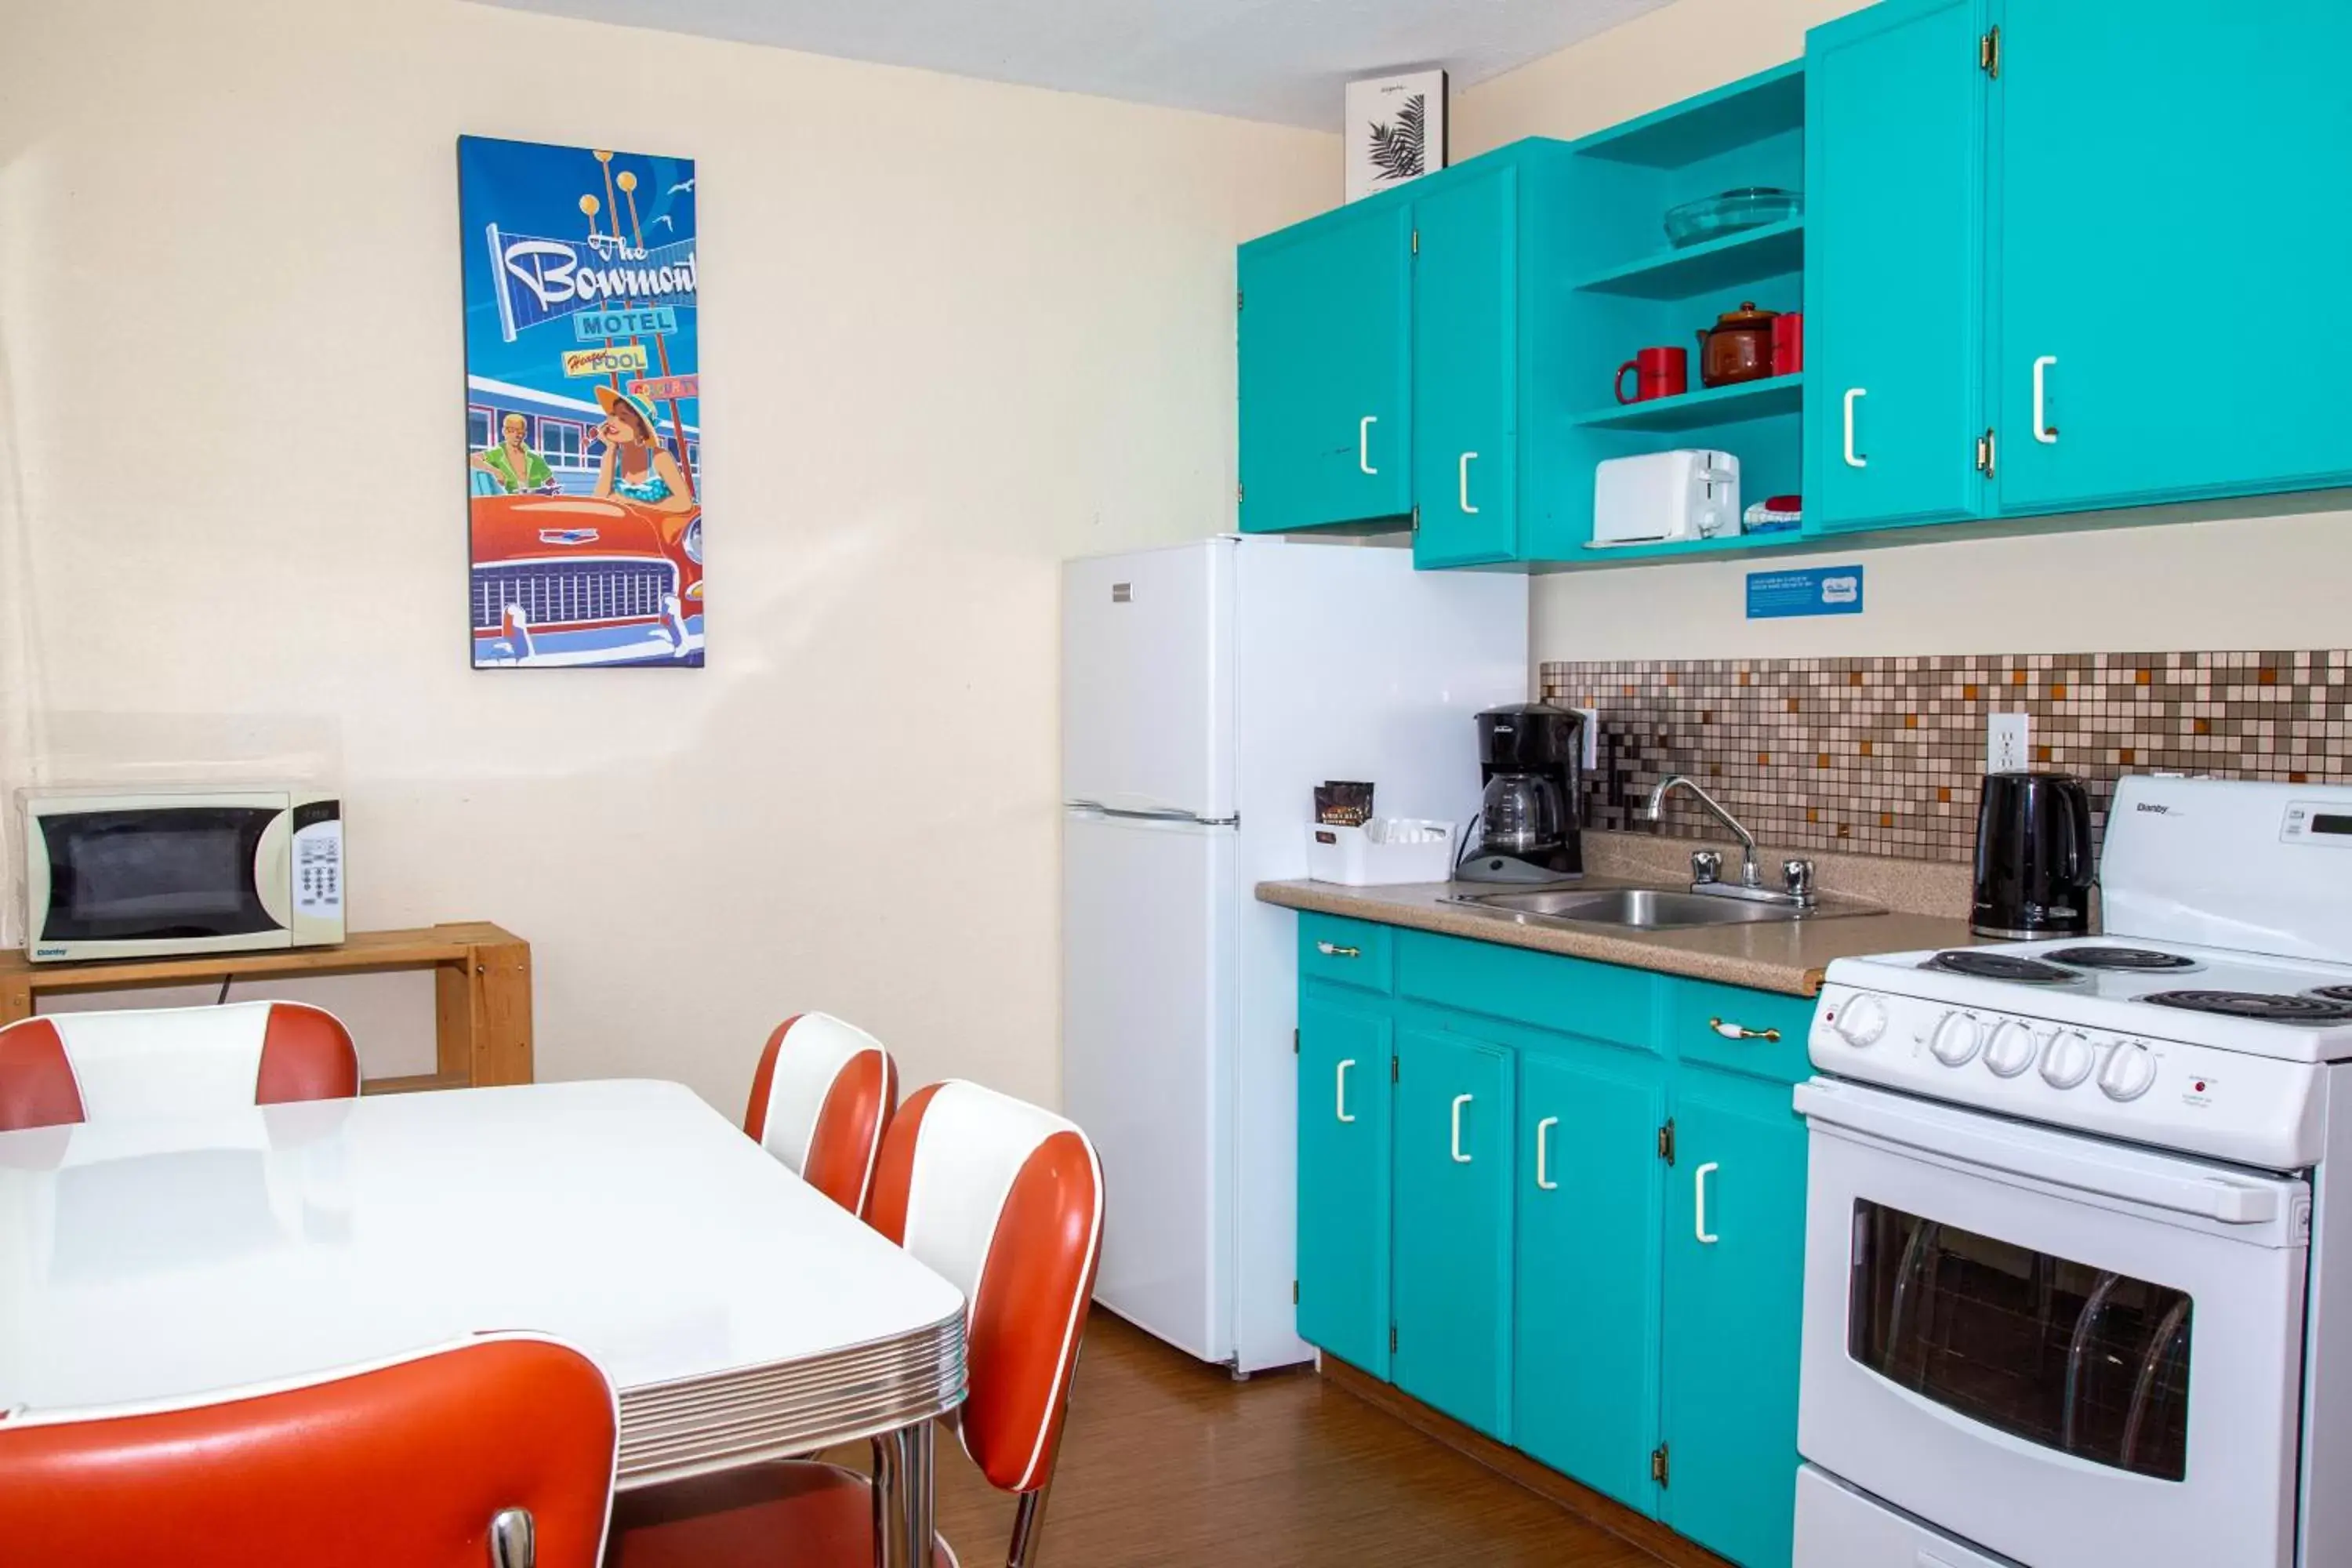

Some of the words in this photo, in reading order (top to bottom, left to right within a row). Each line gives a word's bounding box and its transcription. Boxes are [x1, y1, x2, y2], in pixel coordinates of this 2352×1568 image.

[587, 230, 648, 262] The
[505, 241, 697, 312] Bowmont
[583, 312, 672, 336] MOTEL
[592, 352, 646, 371] POOL
[2136, 802, 2170, 815] Danby
